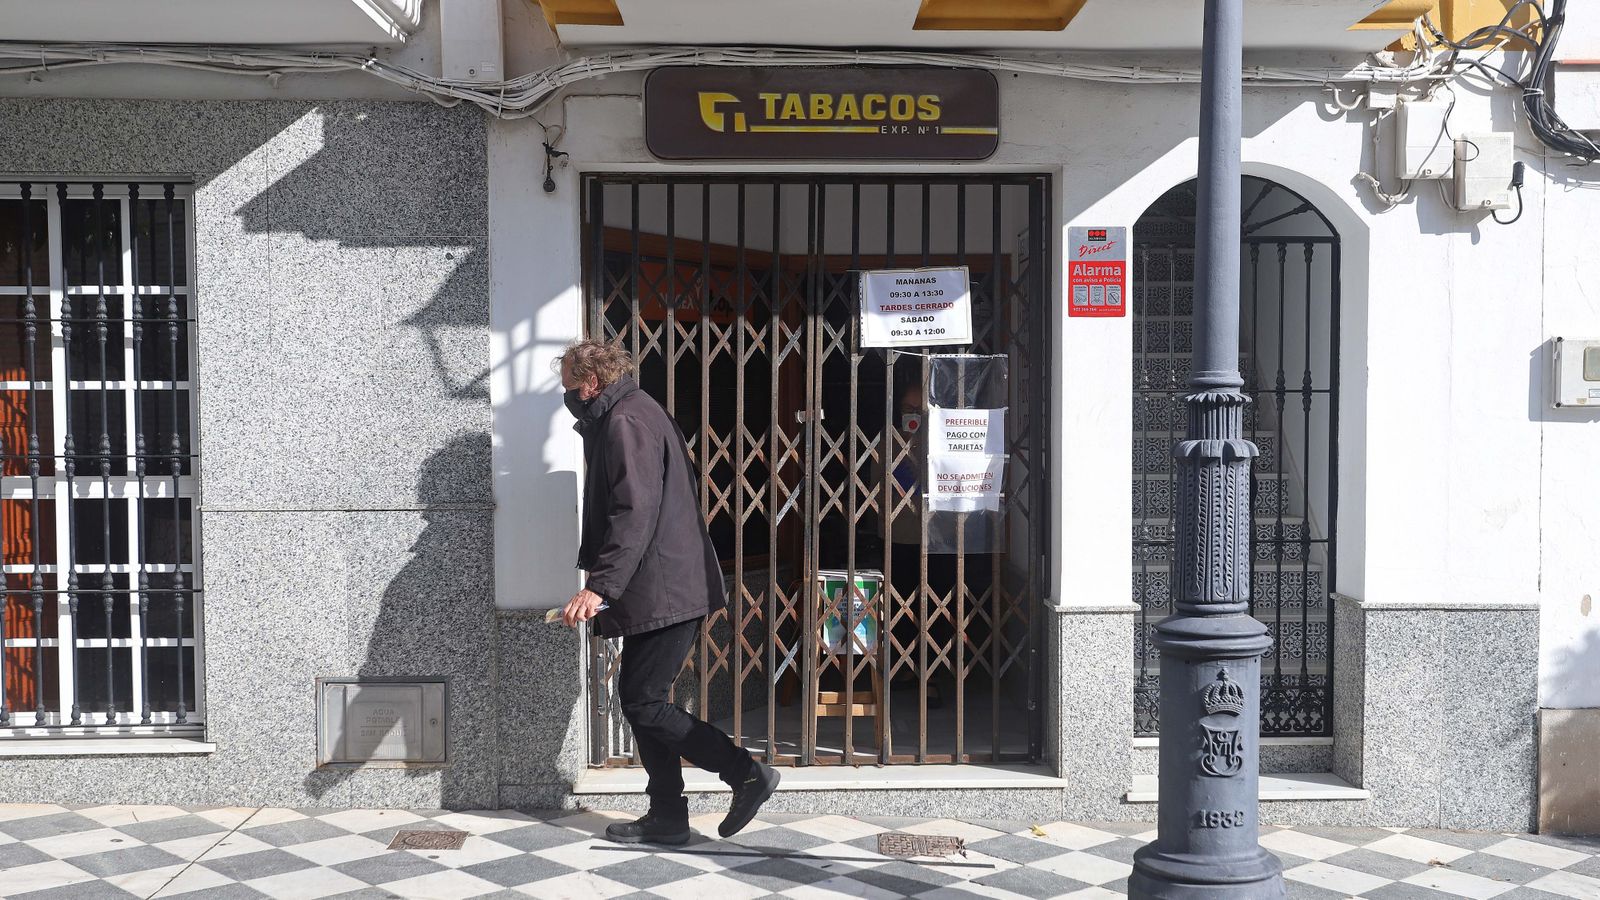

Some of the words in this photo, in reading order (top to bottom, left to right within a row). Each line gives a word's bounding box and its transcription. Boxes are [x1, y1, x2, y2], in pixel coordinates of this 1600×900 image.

[759, 93, 942, 121] TABACOS
[880, 125, 910, 135] EXP.
[1079, 241, 1117, 257] Direct
[1072, 263, 1122, 276] Alarma
[895, 276, 937, 286] MAÑANAS
[889, 291, 912, 299] 09:30
[922, 289, 944, 297] 13:30
[880, 304, 913, 312] TARDES
[915, 301, 955, 311] CERRADO
[890, 329, 913, 337] 09:30
[923, 327, 946, 336] 12:00
[945, 418, 988, 427] PREFERIBLE
[946, 431, 968, 439] PAGO
[948, 443, 984, 451] TARJETAS
[936, 473, 949, 481] NO
[960, 471, 994, 480] ADMITEN
[937, 483, 992, 492] DEVOLUCIONES
[1200, 809, 1244, 828] 1832
